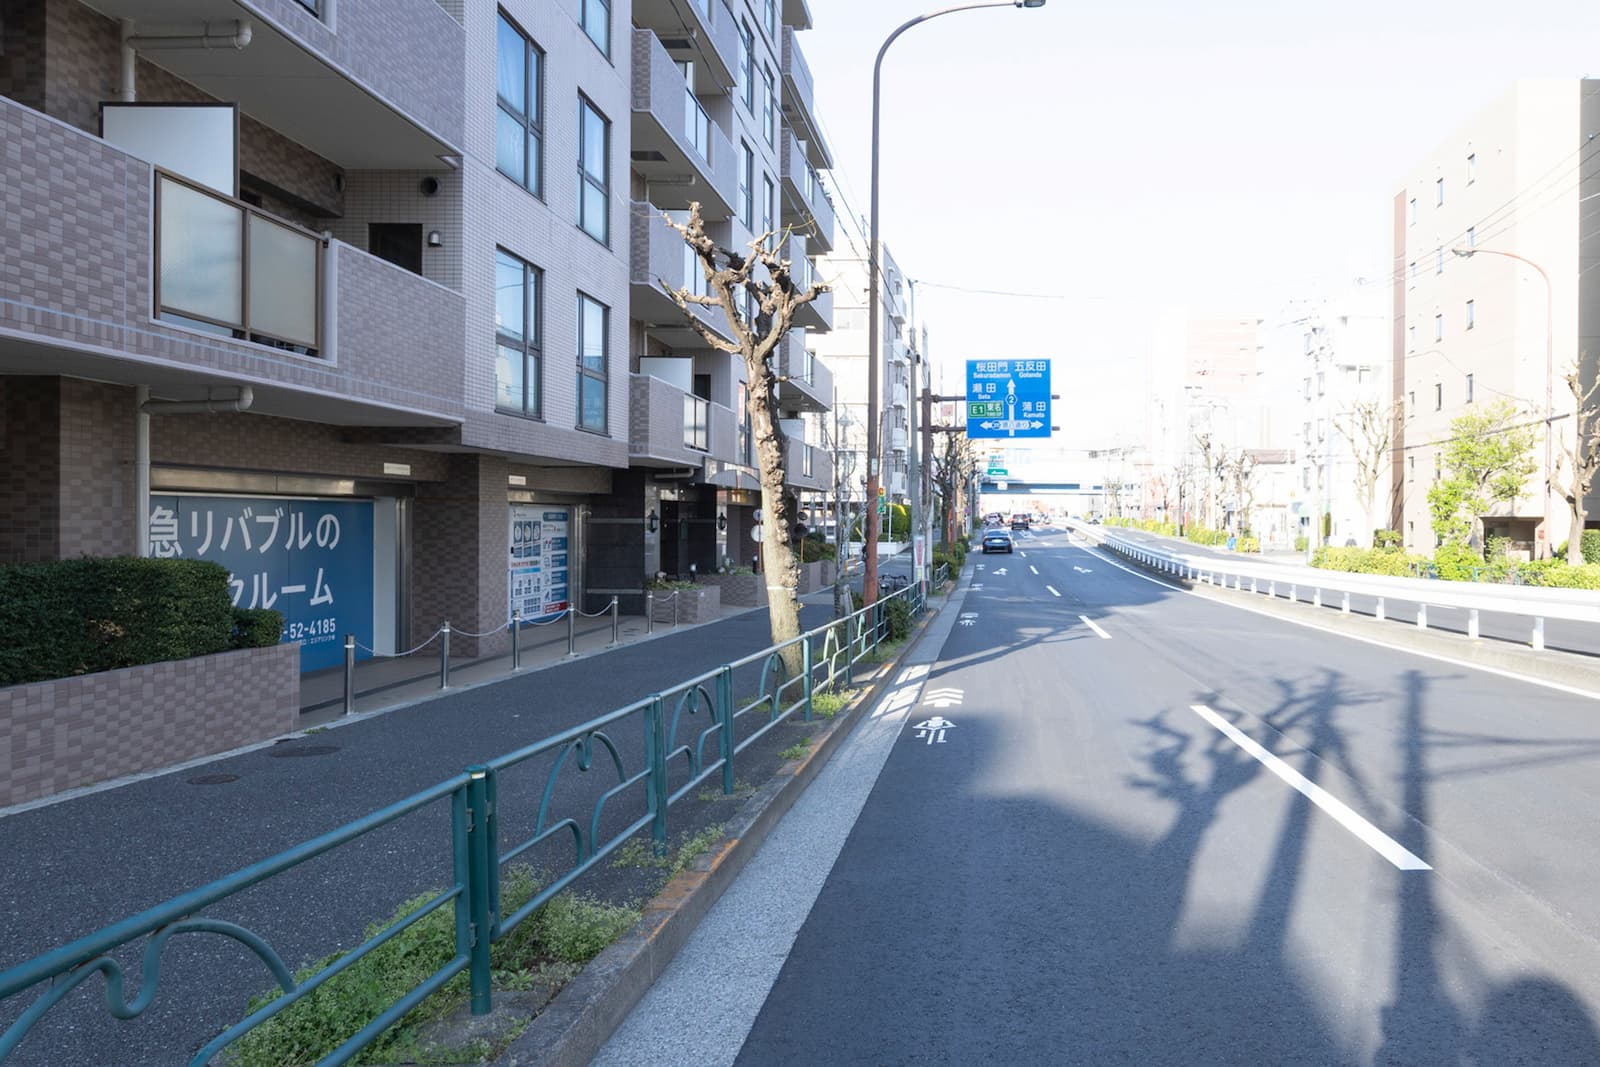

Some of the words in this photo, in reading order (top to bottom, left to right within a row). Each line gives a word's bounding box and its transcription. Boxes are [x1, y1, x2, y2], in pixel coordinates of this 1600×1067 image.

[976, 361, 1008, 372] 桜田門
[1014, 361, 1046, 372] 五反田
[972, 405, 984, 414] E1
[279, 618, 336, 641] -52-4185
